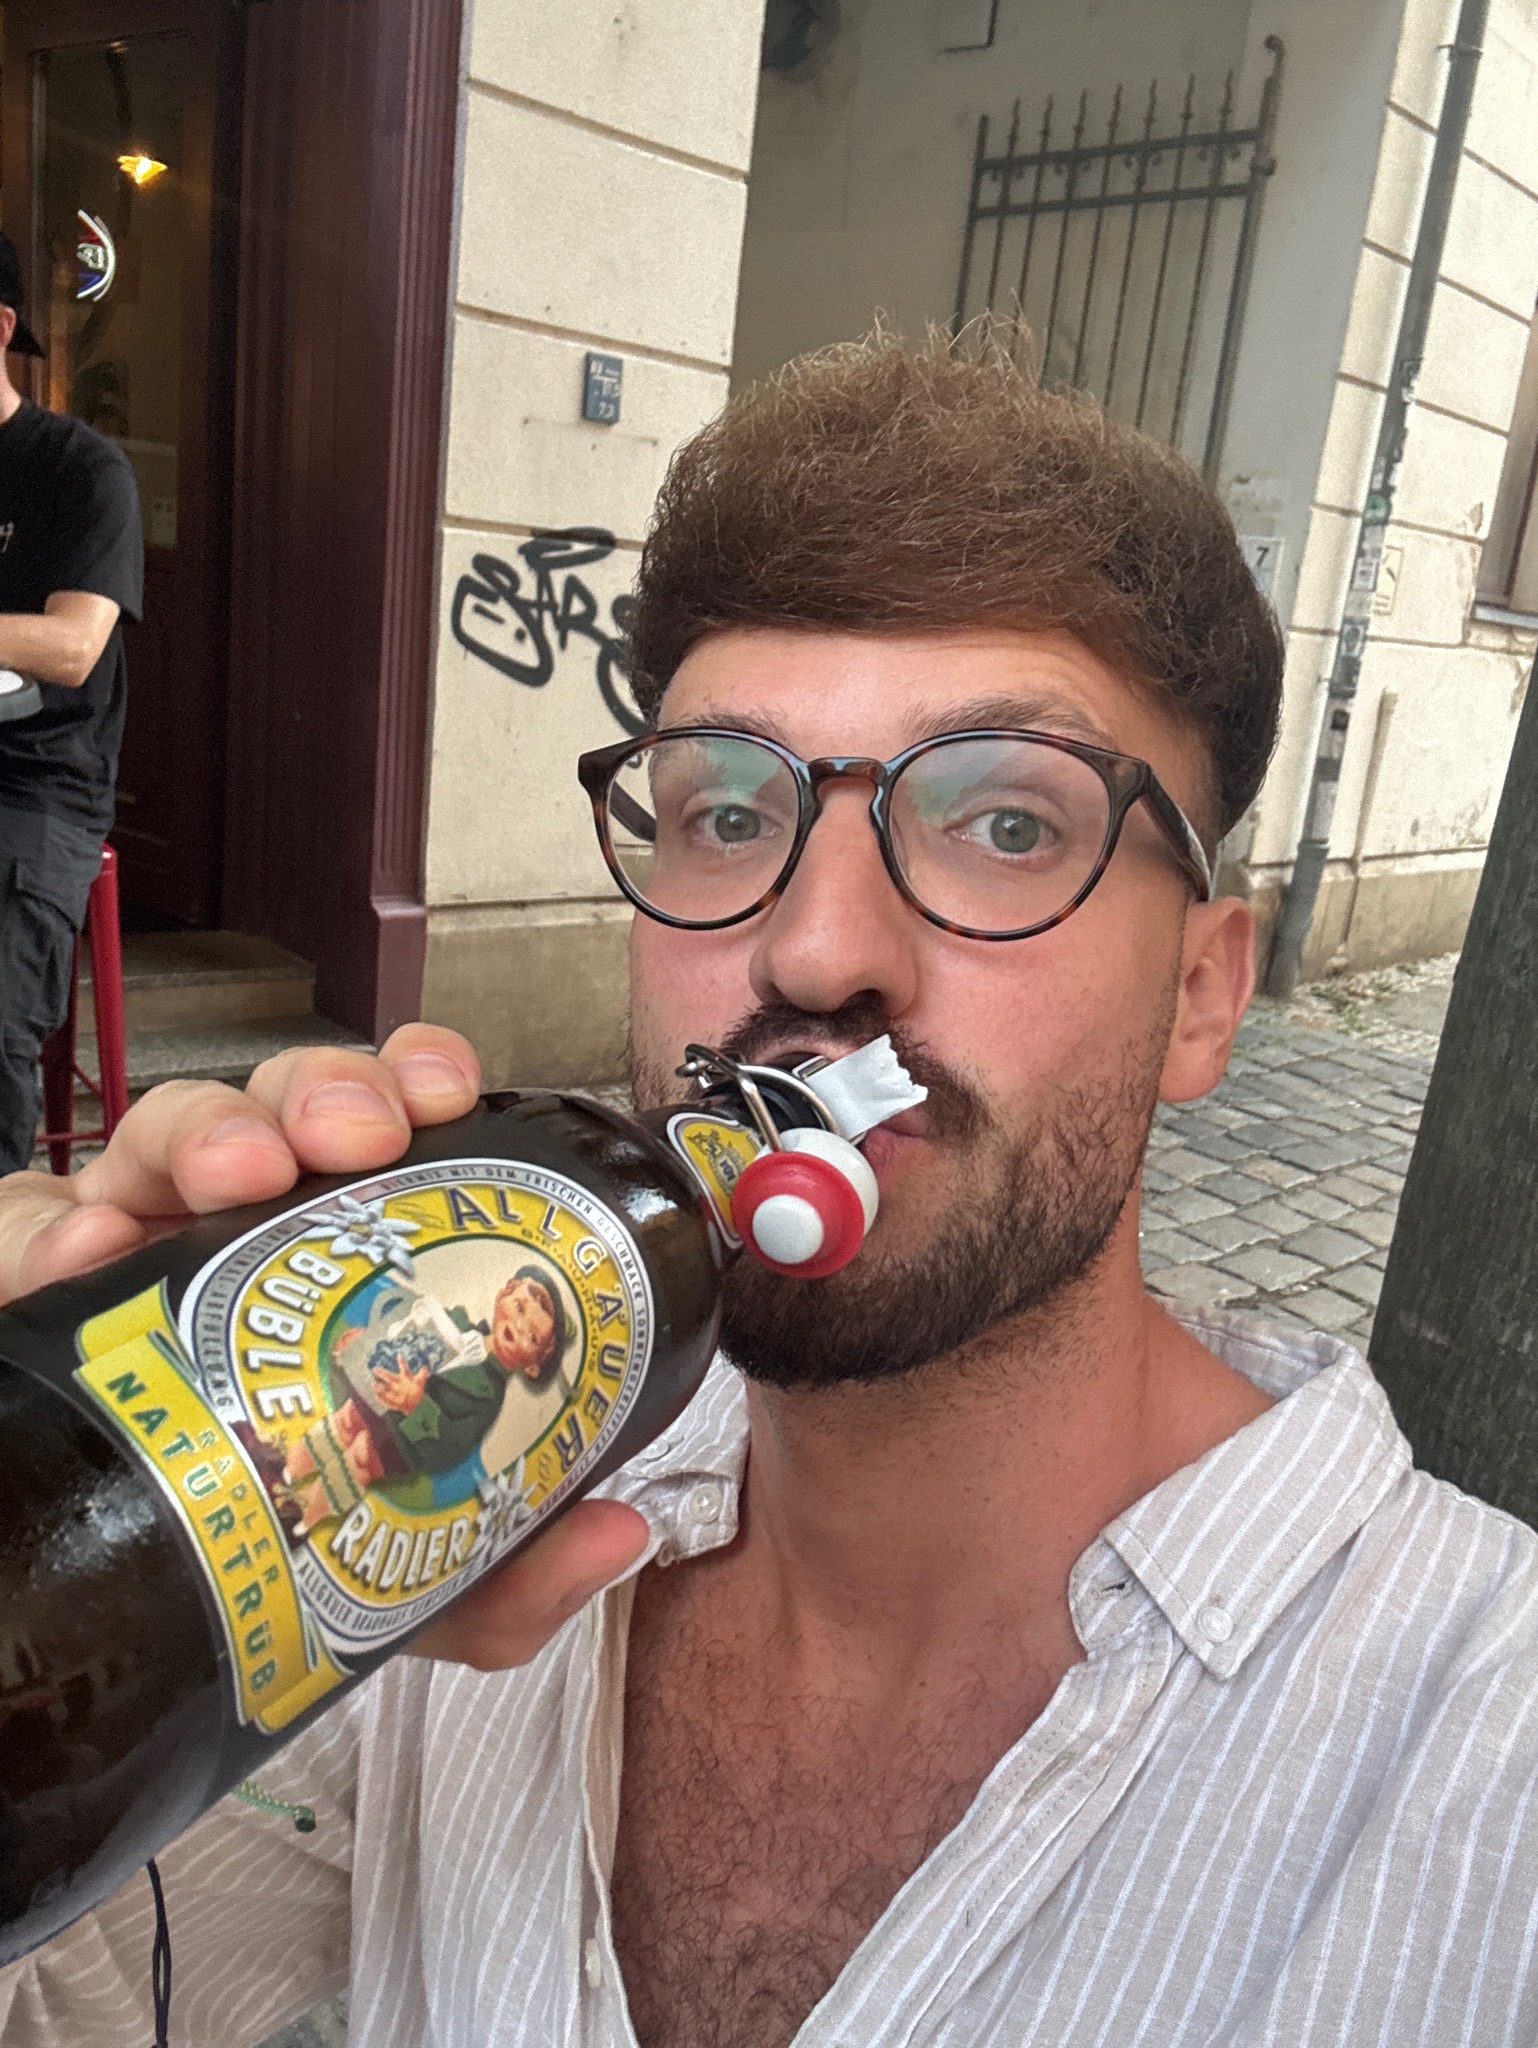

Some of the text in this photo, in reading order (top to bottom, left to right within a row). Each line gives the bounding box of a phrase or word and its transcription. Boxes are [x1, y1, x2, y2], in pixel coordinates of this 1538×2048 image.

[1255, 545, 1270, 567] 7
[449, 1166, 478, 1177] MIT
[485, 1166, 517, 1178] DEM
[524, 1171, 594, 1216] FRISCHEN
[596, 1216, 645, 1299] GESCHMACK
[247, 1250, 346, 1420] BÜBLE
[446, 1184, 627, 1473] ALLGÄUER
[106, 1371, 277, 1691] NATURTRÜB
[198, 1429, 280, 1586] RADLER
[331, 1503, 469, 1590] RADLER
